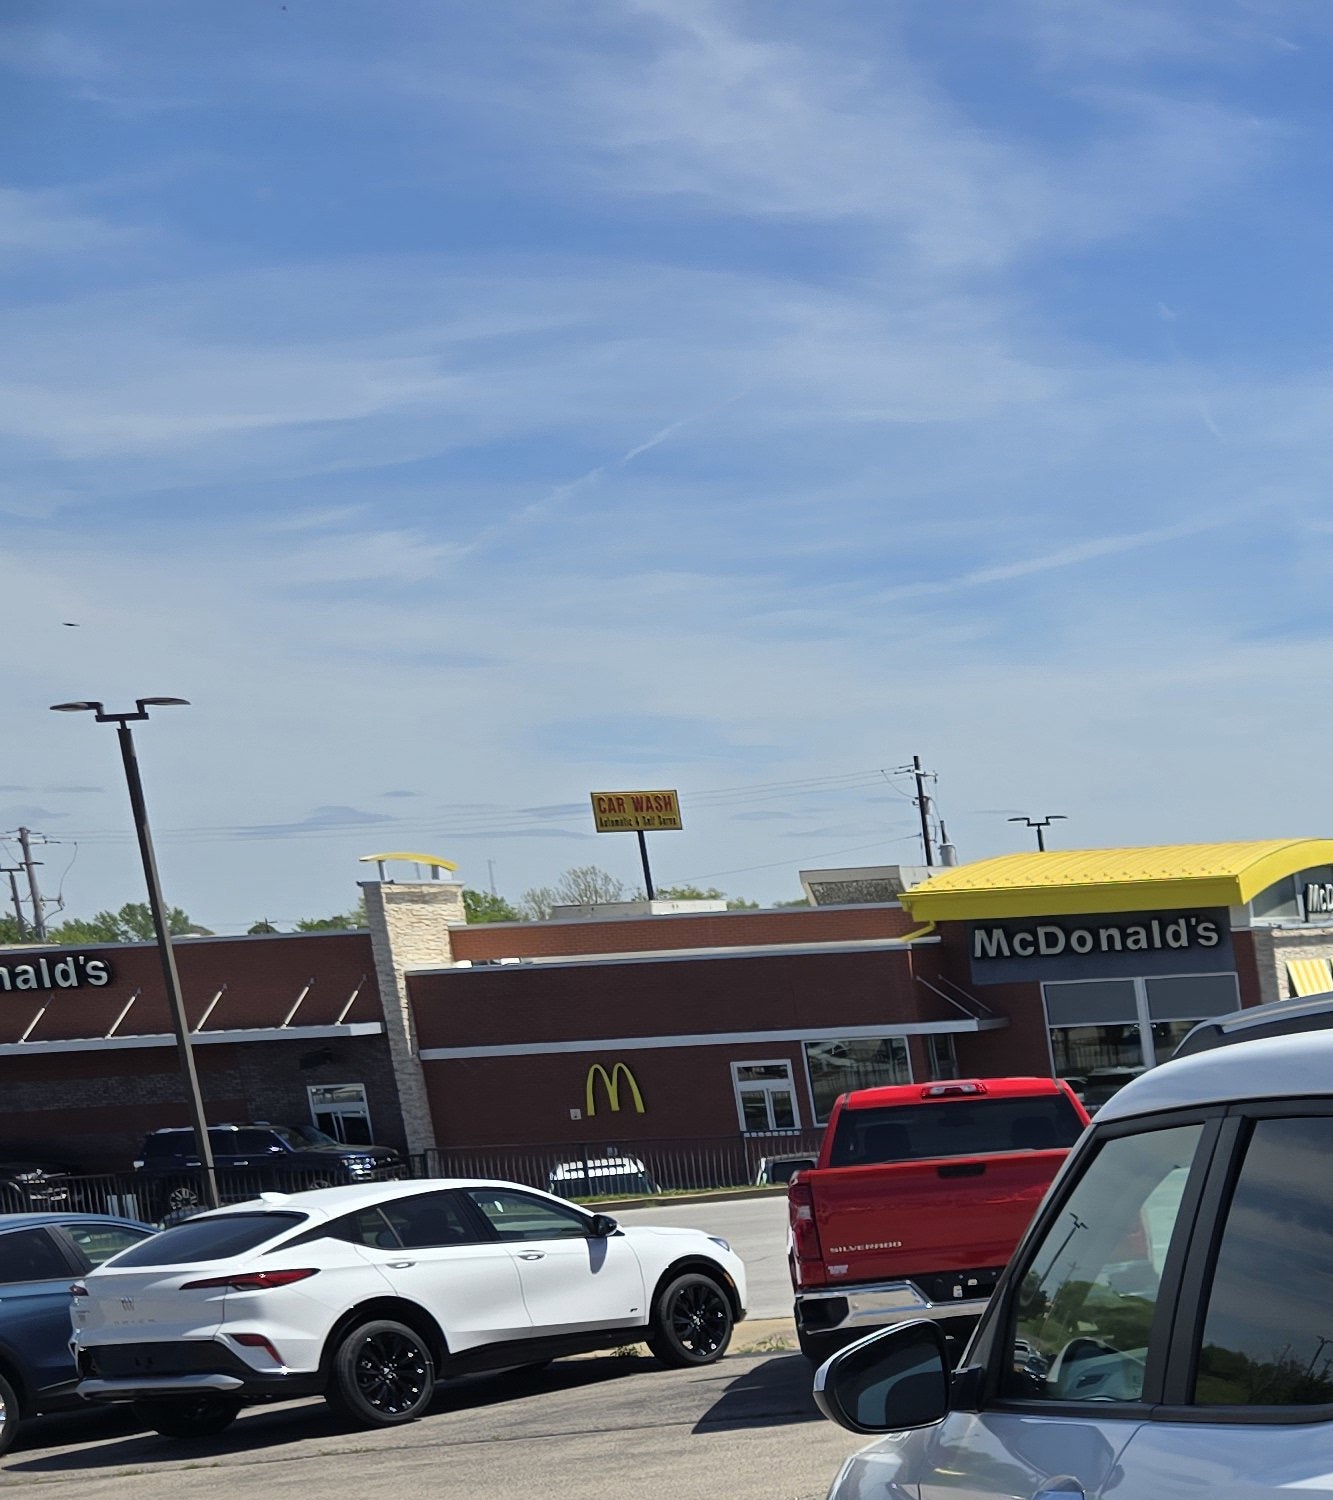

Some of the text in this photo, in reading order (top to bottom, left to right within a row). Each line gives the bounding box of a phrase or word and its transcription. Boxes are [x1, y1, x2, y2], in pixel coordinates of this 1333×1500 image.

[597, 795, 673, 814] CAR WASH
[973, 918, 1219, 958] McDonald's
[0, 955, 109, 991] nald's
[829, 1240, 903, 1254] SILVERADO
